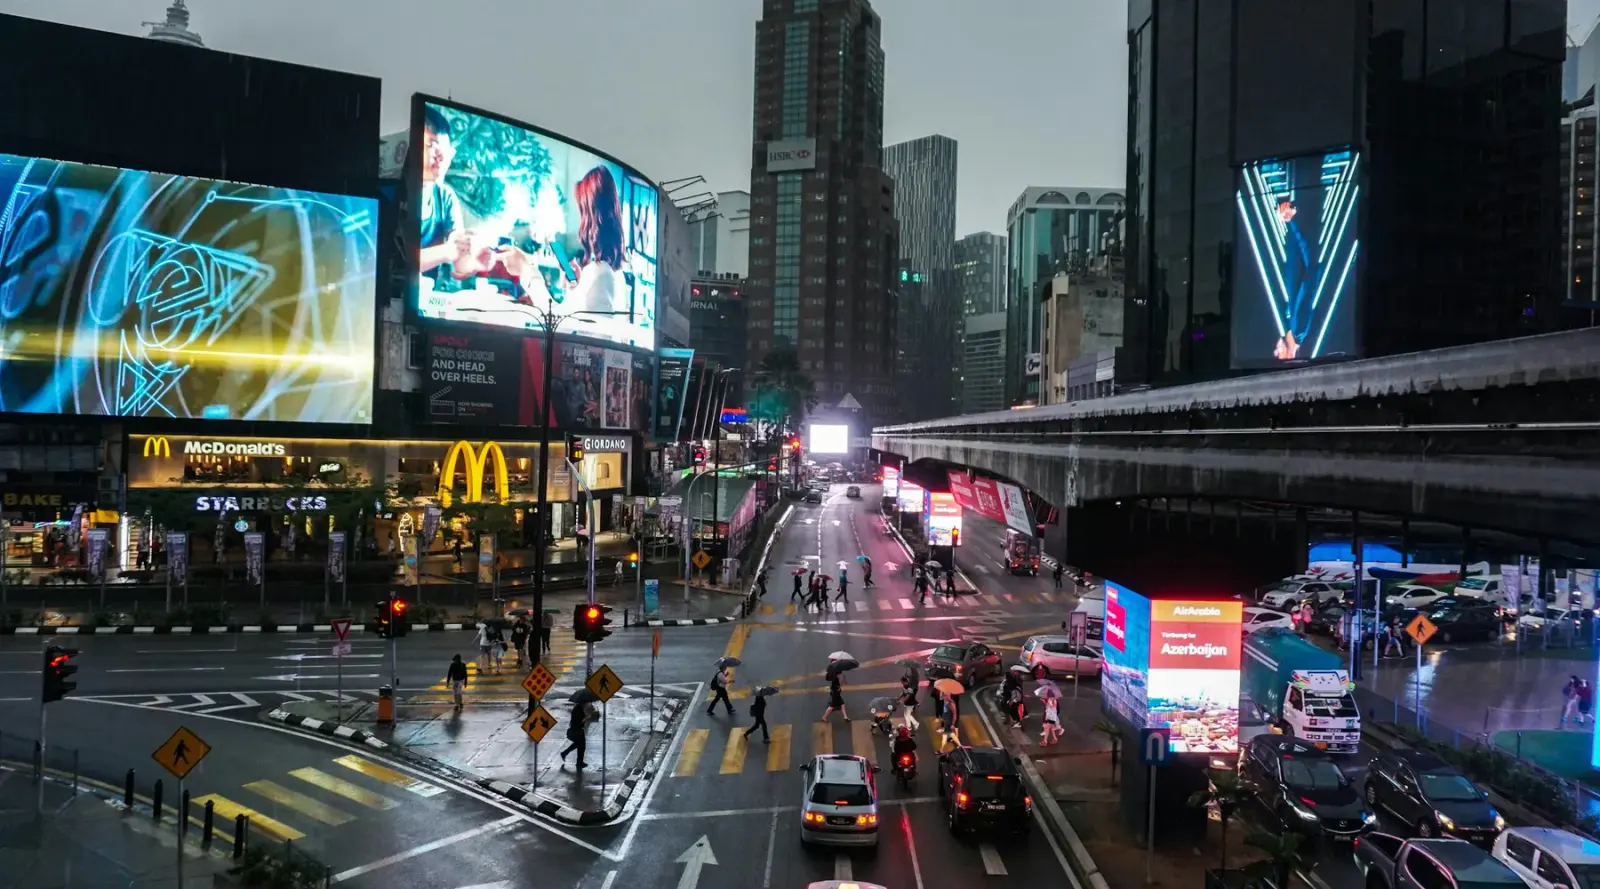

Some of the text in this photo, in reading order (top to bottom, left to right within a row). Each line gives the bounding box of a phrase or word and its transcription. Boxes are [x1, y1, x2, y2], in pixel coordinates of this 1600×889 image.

[769, 150, 796, 161] HSBC
[431, 359, 486, 373] AND HEAD
[431, 371, 497, 385] OVER HEELS.
[184, 441, 285, 455] McDonald's
[584, 437, 626, 450] GIORDANO
[3, 492, 62, 506] BAKE
[1161, 643, 1228, 658] Azerbaijan
